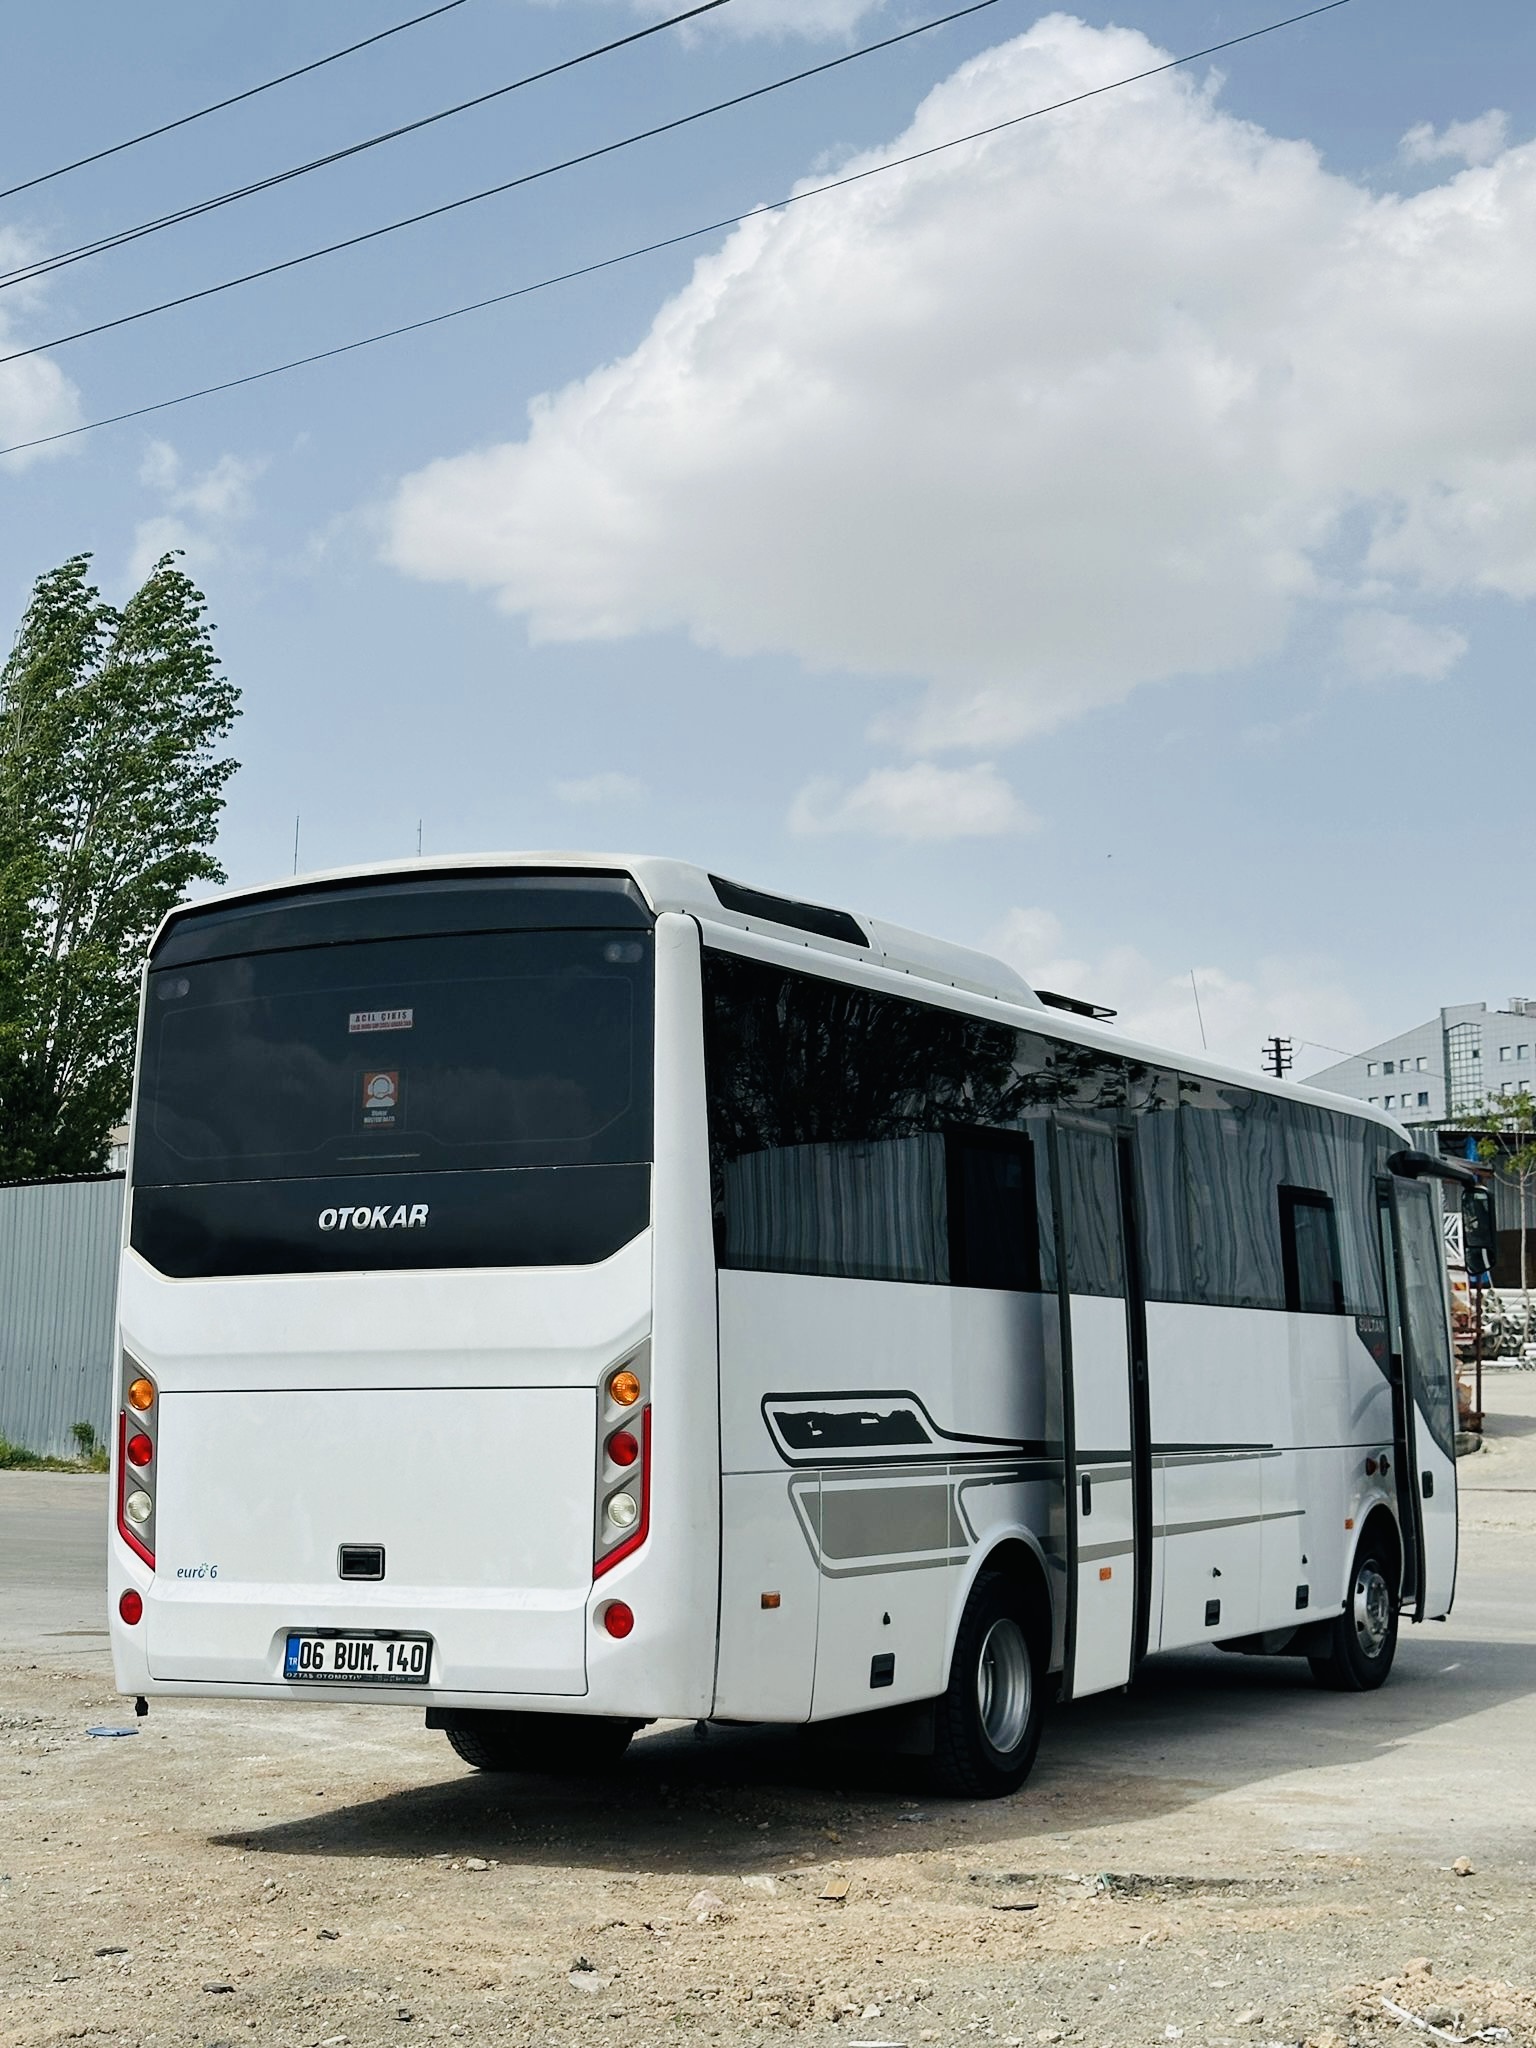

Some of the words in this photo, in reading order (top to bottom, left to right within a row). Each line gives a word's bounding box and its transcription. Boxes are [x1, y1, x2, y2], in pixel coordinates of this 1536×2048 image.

[318, 1204, 429, 1231] OTOKAR
[177, 1565, 207, 1579] euro
[210, 1565, 218, 1579] 6
[289, 1656, 298, 1666] TR
[300, 1641, 325, 1670] 06
[386, 1643, 424, 1672] 140
